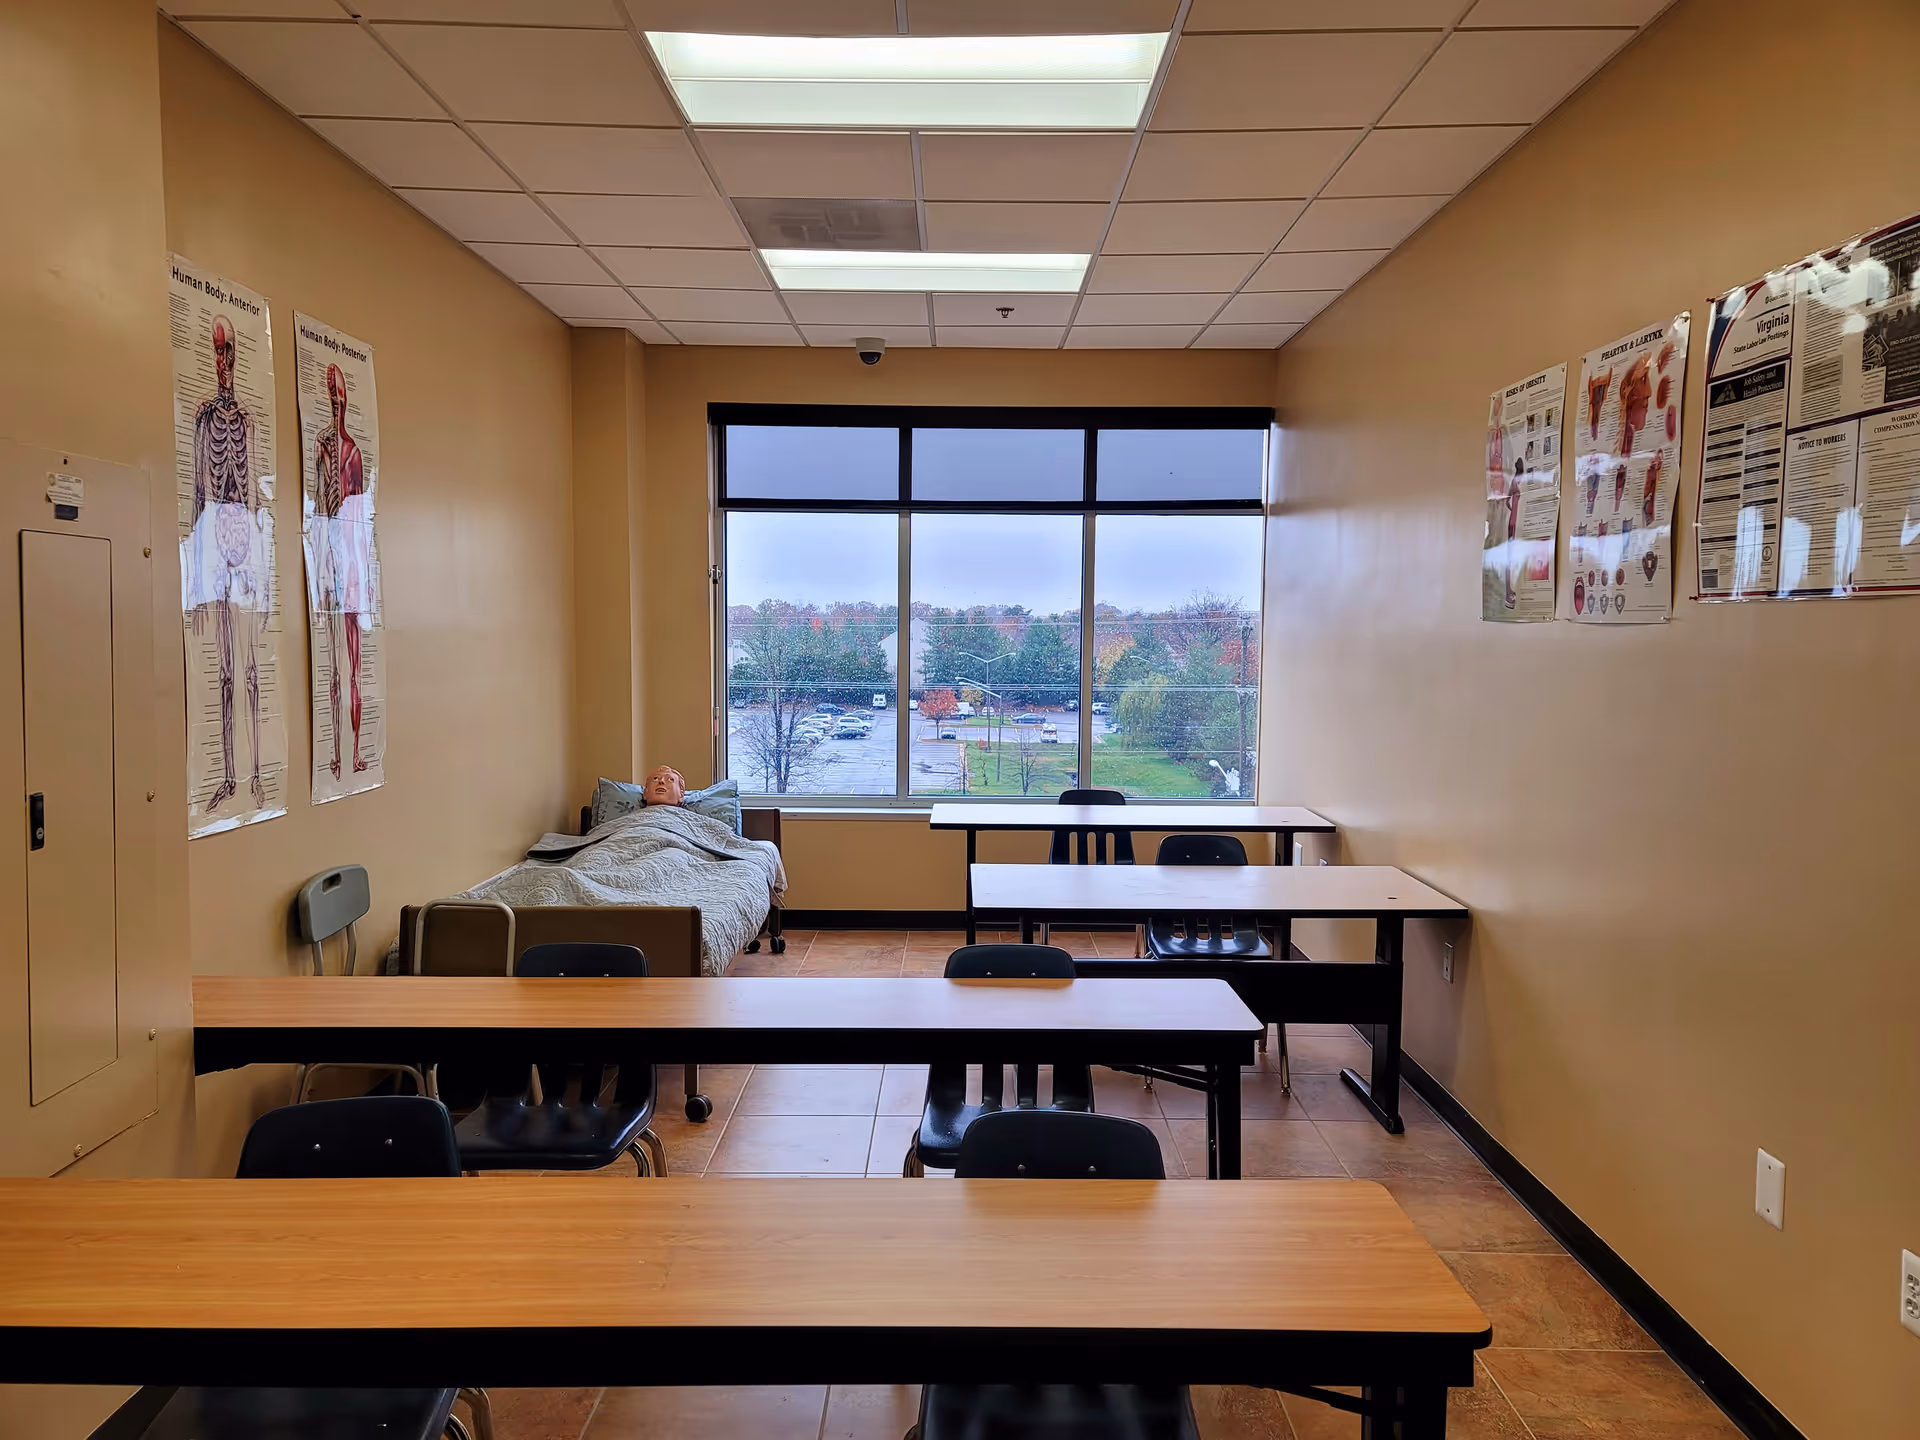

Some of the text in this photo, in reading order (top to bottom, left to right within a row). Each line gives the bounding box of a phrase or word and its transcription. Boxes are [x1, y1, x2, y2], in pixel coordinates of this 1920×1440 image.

[172, 265, 260, 316] Human Body: Anterior
[1756, 312, 1790, 334] Virginia
[300, 324, 367, 363] Human Body: Posterior
[1600, 342, 1630, 362] PHARYNX
[1634, 328, 1664, 348] LARYNX
[1733, 330, 1789, 354] State Labor Law Postings
[1873, 420, 1915, 434] COMPENSATION
[1798, 432, 1847, 451] NOTICE TO WORKERS
